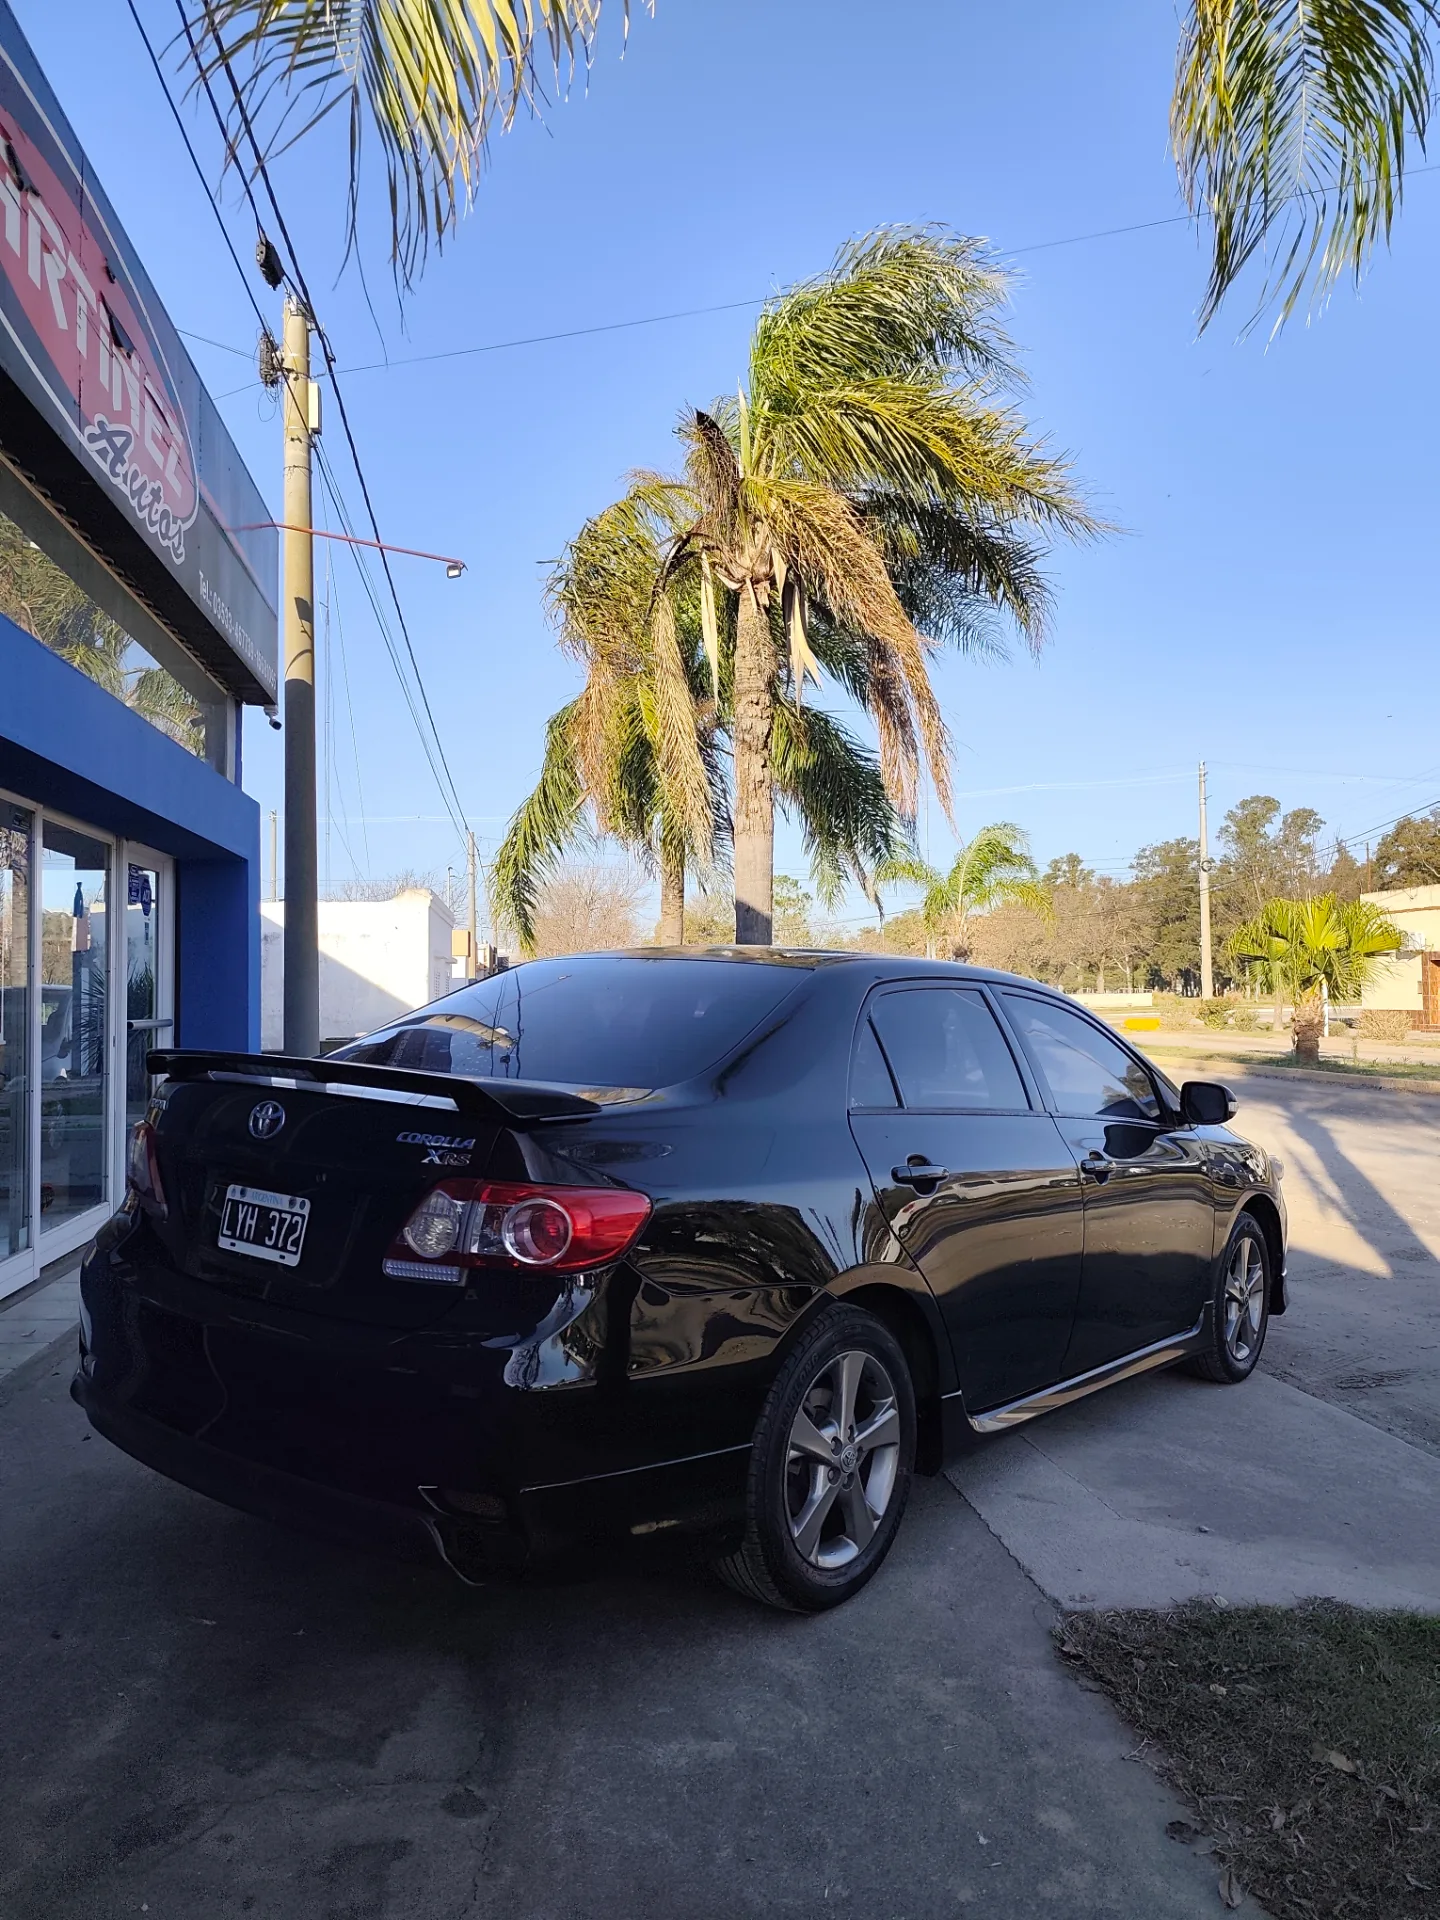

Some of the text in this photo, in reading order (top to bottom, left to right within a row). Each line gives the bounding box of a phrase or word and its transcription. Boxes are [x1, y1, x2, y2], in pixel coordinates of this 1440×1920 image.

[84, 413, 186, 566] Autos
[395, 1131, 477, 1150] COROLLA
[420, 1148, 473, 1167] XRS
[222, 1200, 303, 1252] LYH 372
